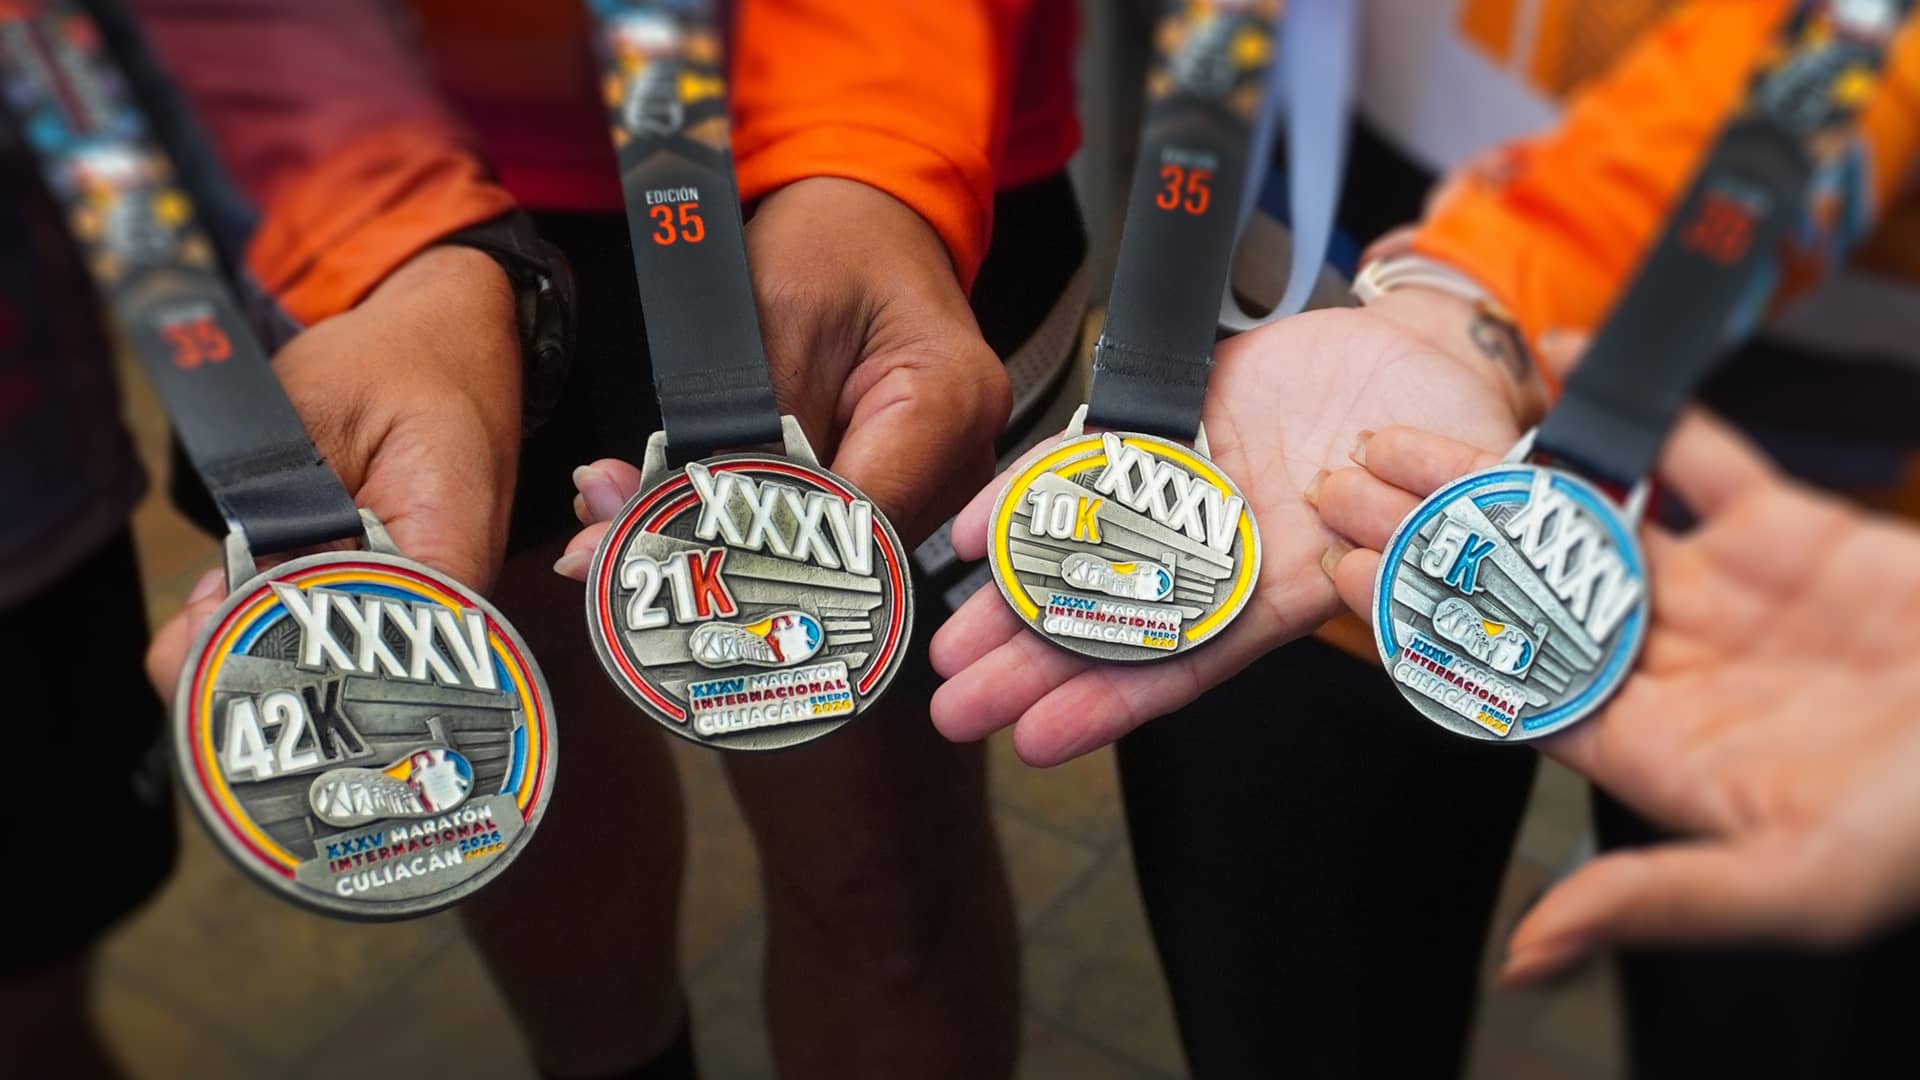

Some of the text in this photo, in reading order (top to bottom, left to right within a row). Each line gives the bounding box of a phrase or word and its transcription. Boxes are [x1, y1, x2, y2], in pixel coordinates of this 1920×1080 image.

[646, 186, 698, 204] EDICIÓN
[1156, 164, 1214, 216] 35
[649, 203, 705, 245] 35
[162, 316, 232, 369] 35
[685, 462, 874, 576] XXXV
[1028, 490, 1102, 544] 10K
[1094, 432, 1243, 554] XXXV
[1421, 519, 1495, 593] 5K
[1506, 469, 1641, 642] XXXV
[621, 547, 738, 630] 21K
[1050, 594, 1096, 610] XXXV
[268, 581, 500, 694] XXXV
[1045, 618, 1177, 642] CULIACÁN ENERO
[1048, 606, 1177, 632] INTERNACIONAL
[1411, 638, 1452, 664] XXXV
[690, 665, 844, 697] XXXV MARATÓN
[694, 680, 846, 710] INTERNACIONAL
[1395, 662, 1512, 724] CULIACÁN ENERO
[1404, 648, 1516, 716] INTERNACIONAL
[226, 679, 375, 783] 42K
[698, 692, 850, 730] CULIACÁN ENERO
[813, 701, 852, 715] 2026
[325, 804, 493, 860] XXXV MARATÓN
[329, 820, 497, 872] INTERNACIONAL
[337, 832, 502, 897] CULIACÁN 2026
